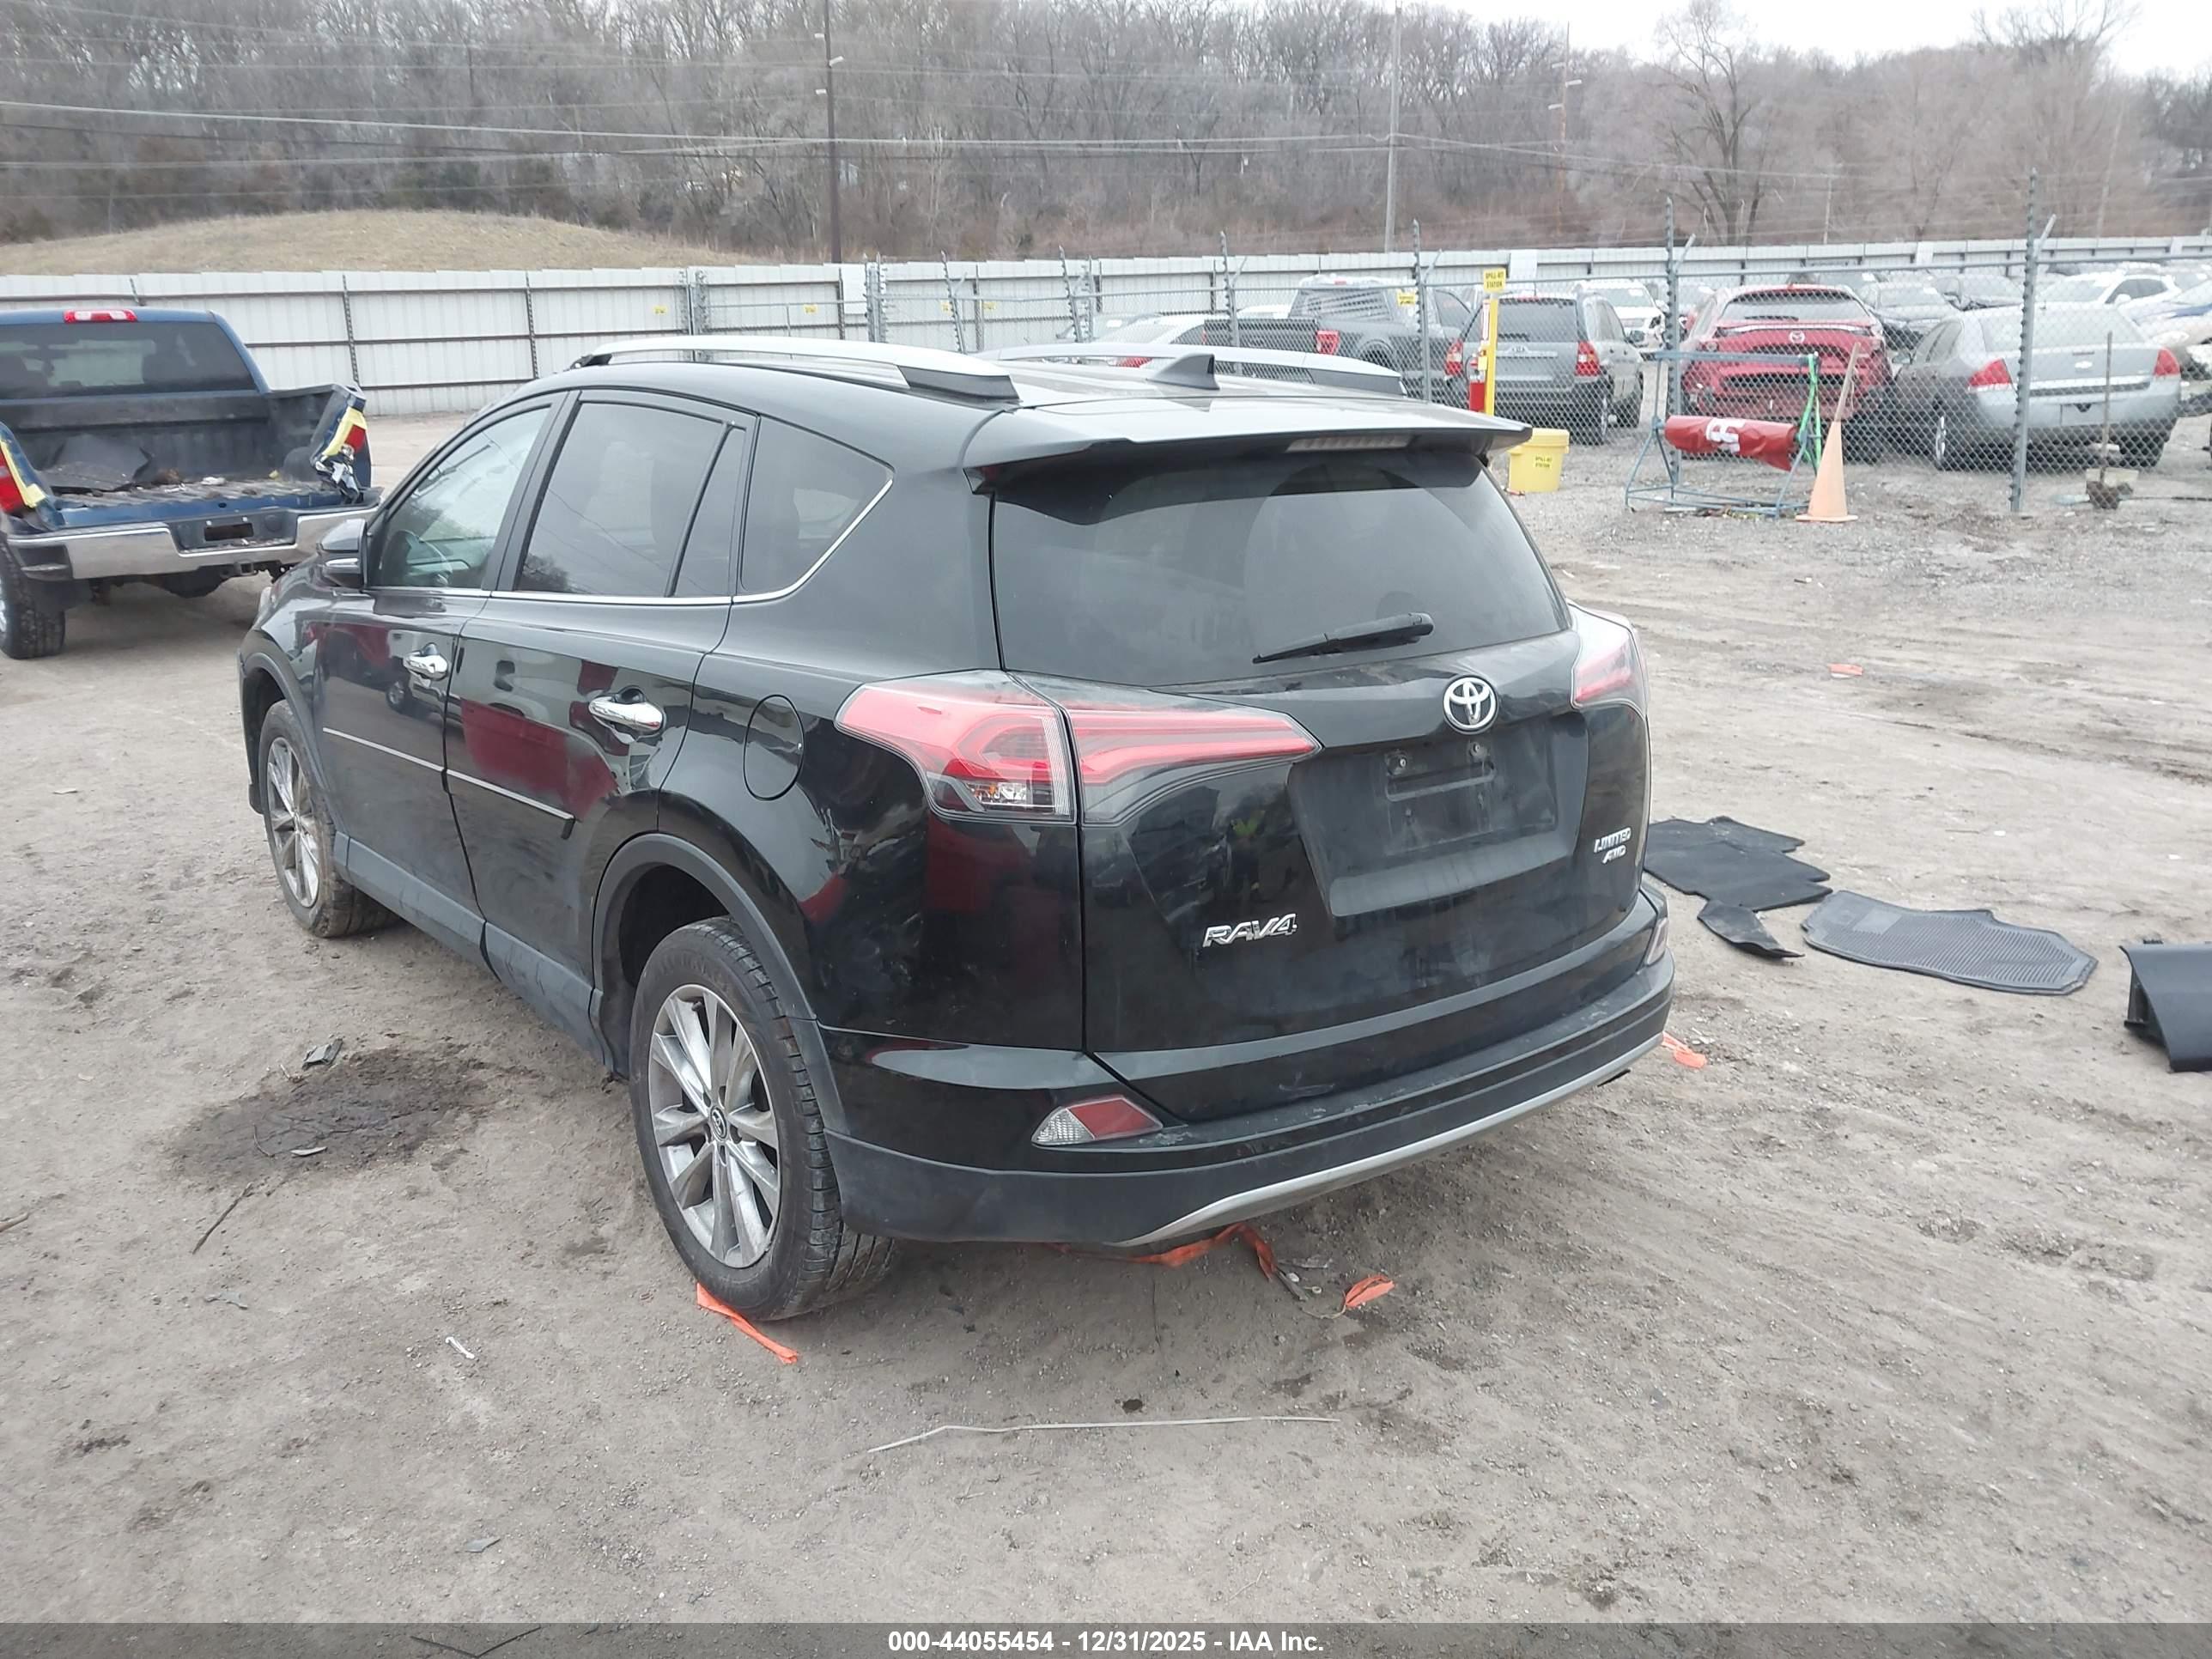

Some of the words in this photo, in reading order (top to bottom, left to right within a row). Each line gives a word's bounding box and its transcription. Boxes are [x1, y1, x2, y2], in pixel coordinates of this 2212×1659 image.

[1594, 827, 1632, 854] LIMITED
[1602, 845, 1626, 864] AWD
[1202, 913, 1297, 948] RAV4
